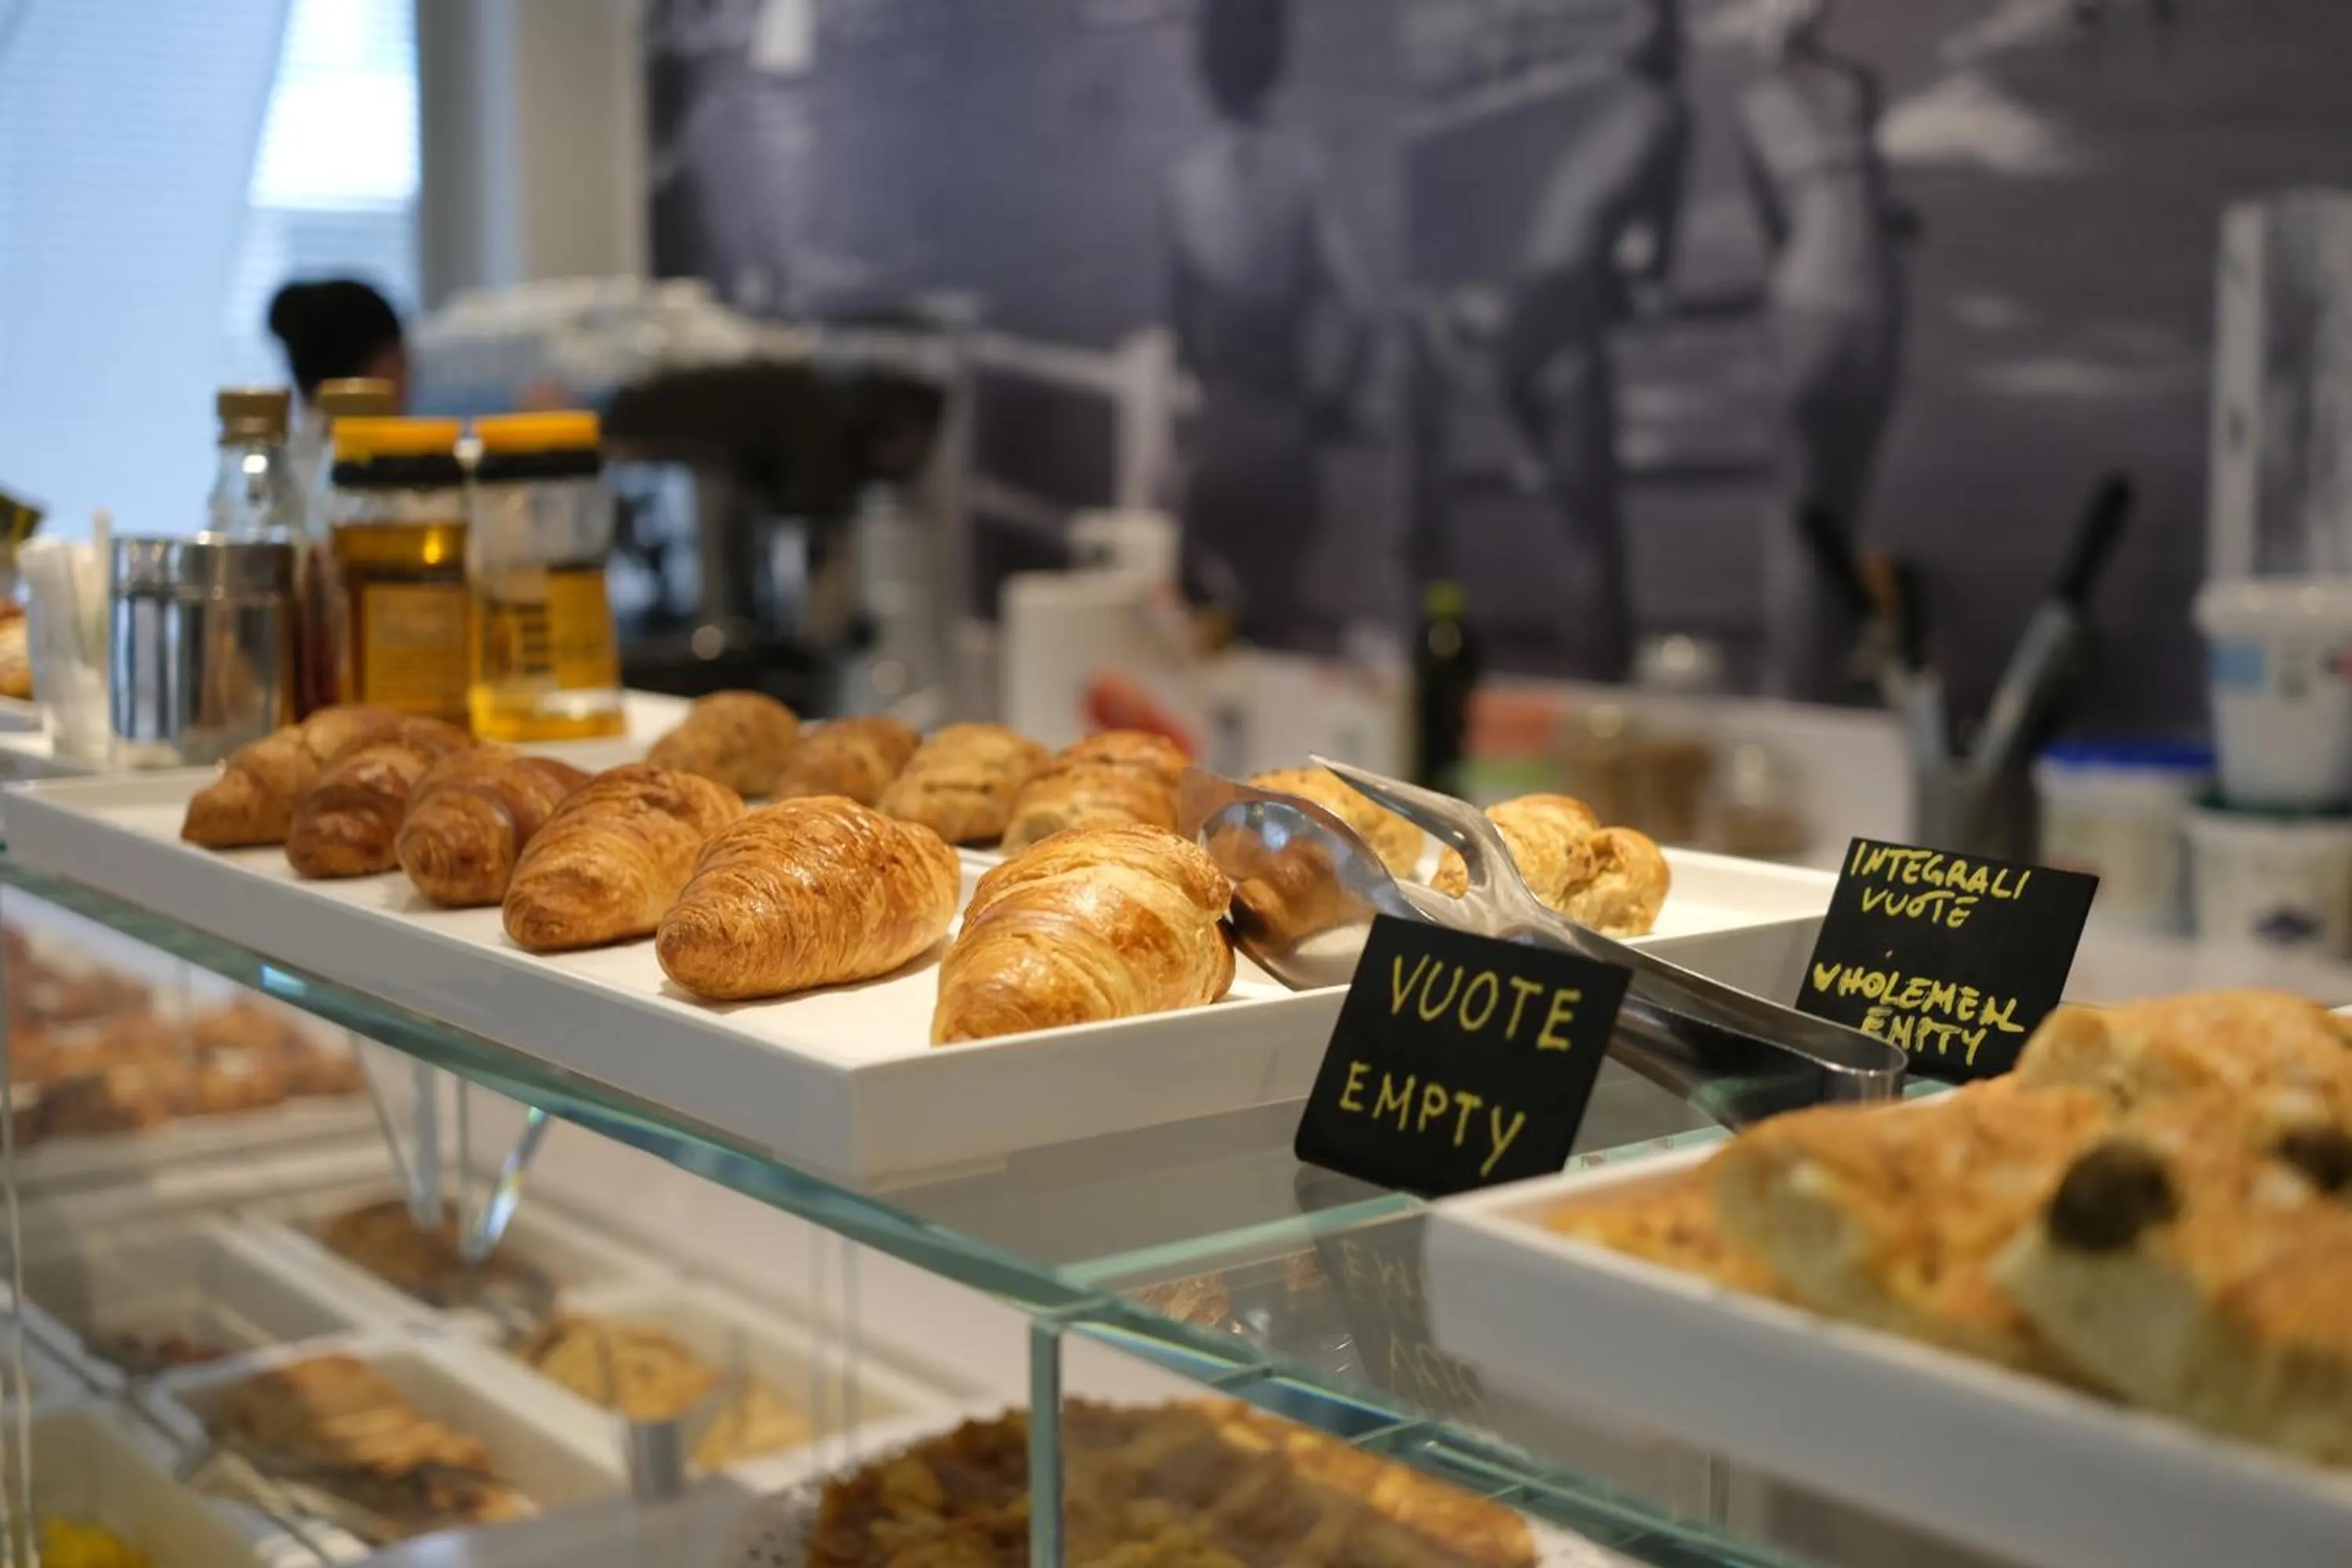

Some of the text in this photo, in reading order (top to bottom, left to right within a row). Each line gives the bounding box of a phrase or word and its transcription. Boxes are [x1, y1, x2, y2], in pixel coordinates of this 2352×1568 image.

[1849, 840, 2031, 901] INTEGRALI
[1861, 886, 1980, 929] VUOTE
[1390, 953, 1583, 1051] VUOTE
[1859, 1005, 1988, 1066] EMPTY
[1339, 1060, 1526, 1177] EMPTY
